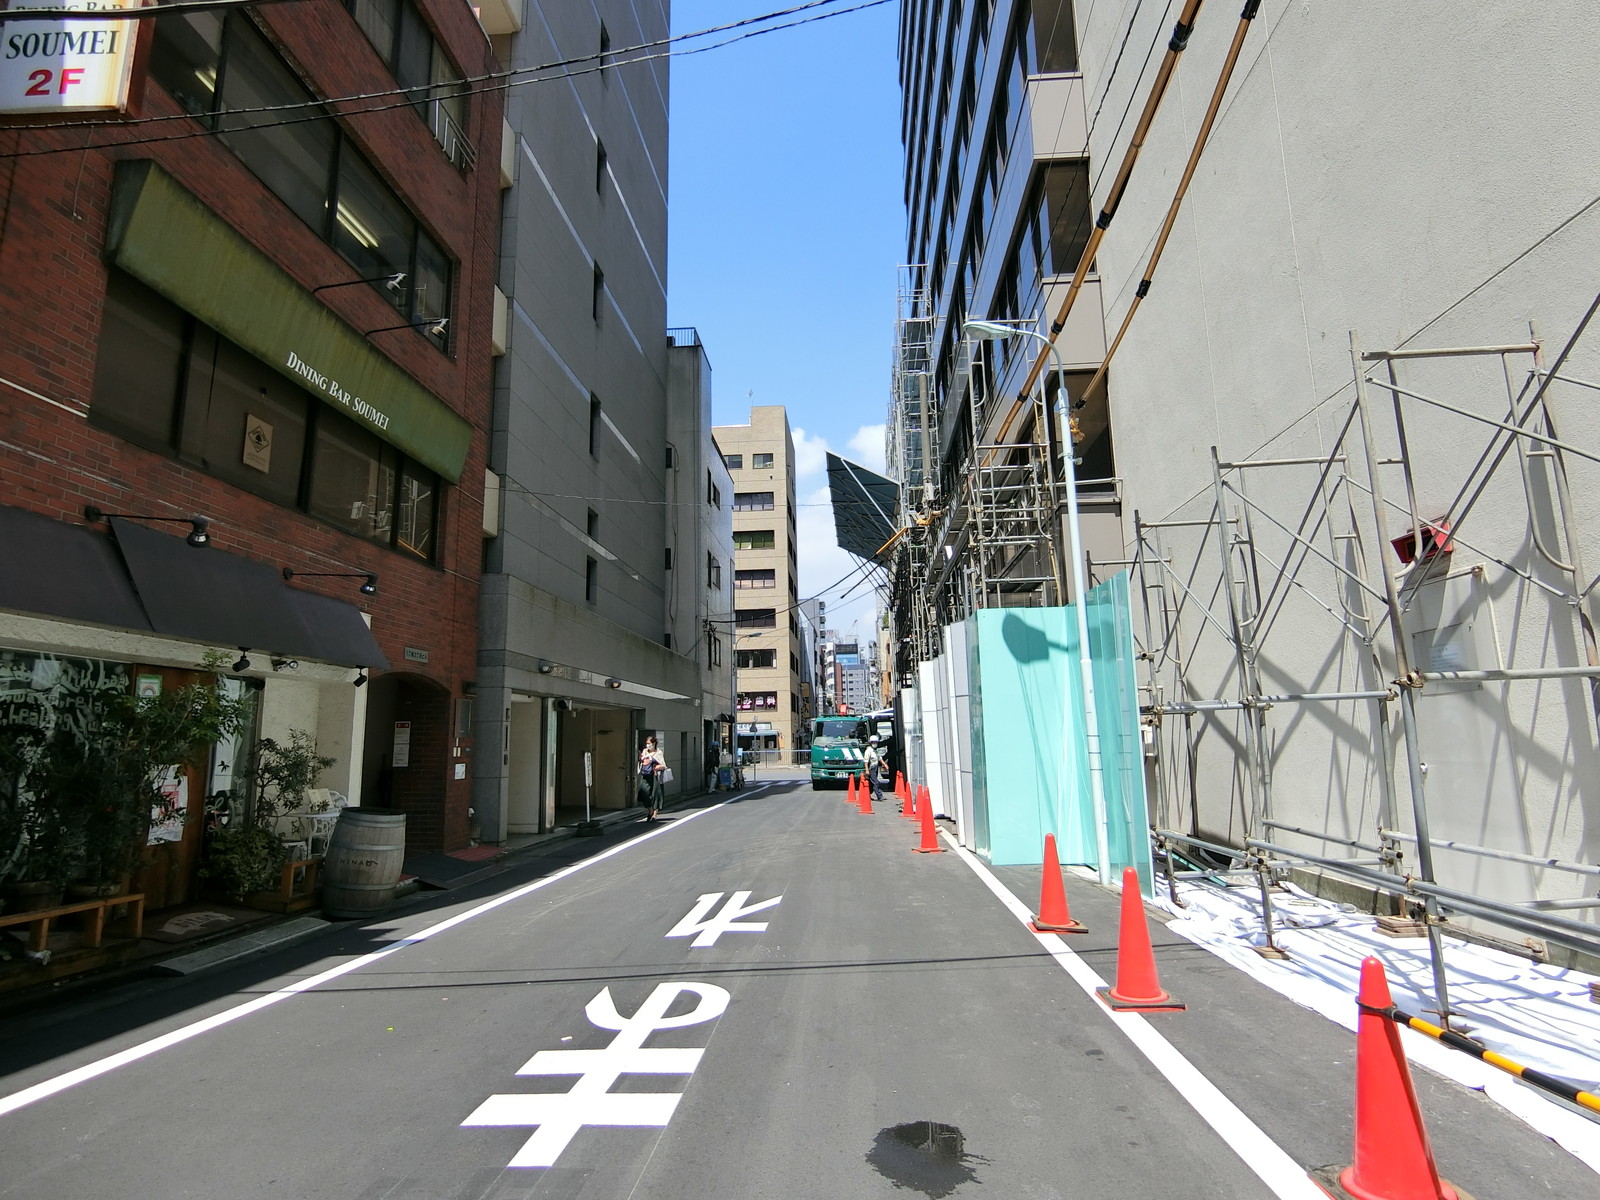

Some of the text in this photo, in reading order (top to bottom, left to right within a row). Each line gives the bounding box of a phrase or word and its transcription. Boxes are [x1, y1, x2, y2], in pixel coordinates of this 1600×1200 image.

[6, 30, 120, 59] SOUMEI
[25, 68, 85, 96] 2F
[286, 351, 389, 431] DINING BAR SOUMEI
